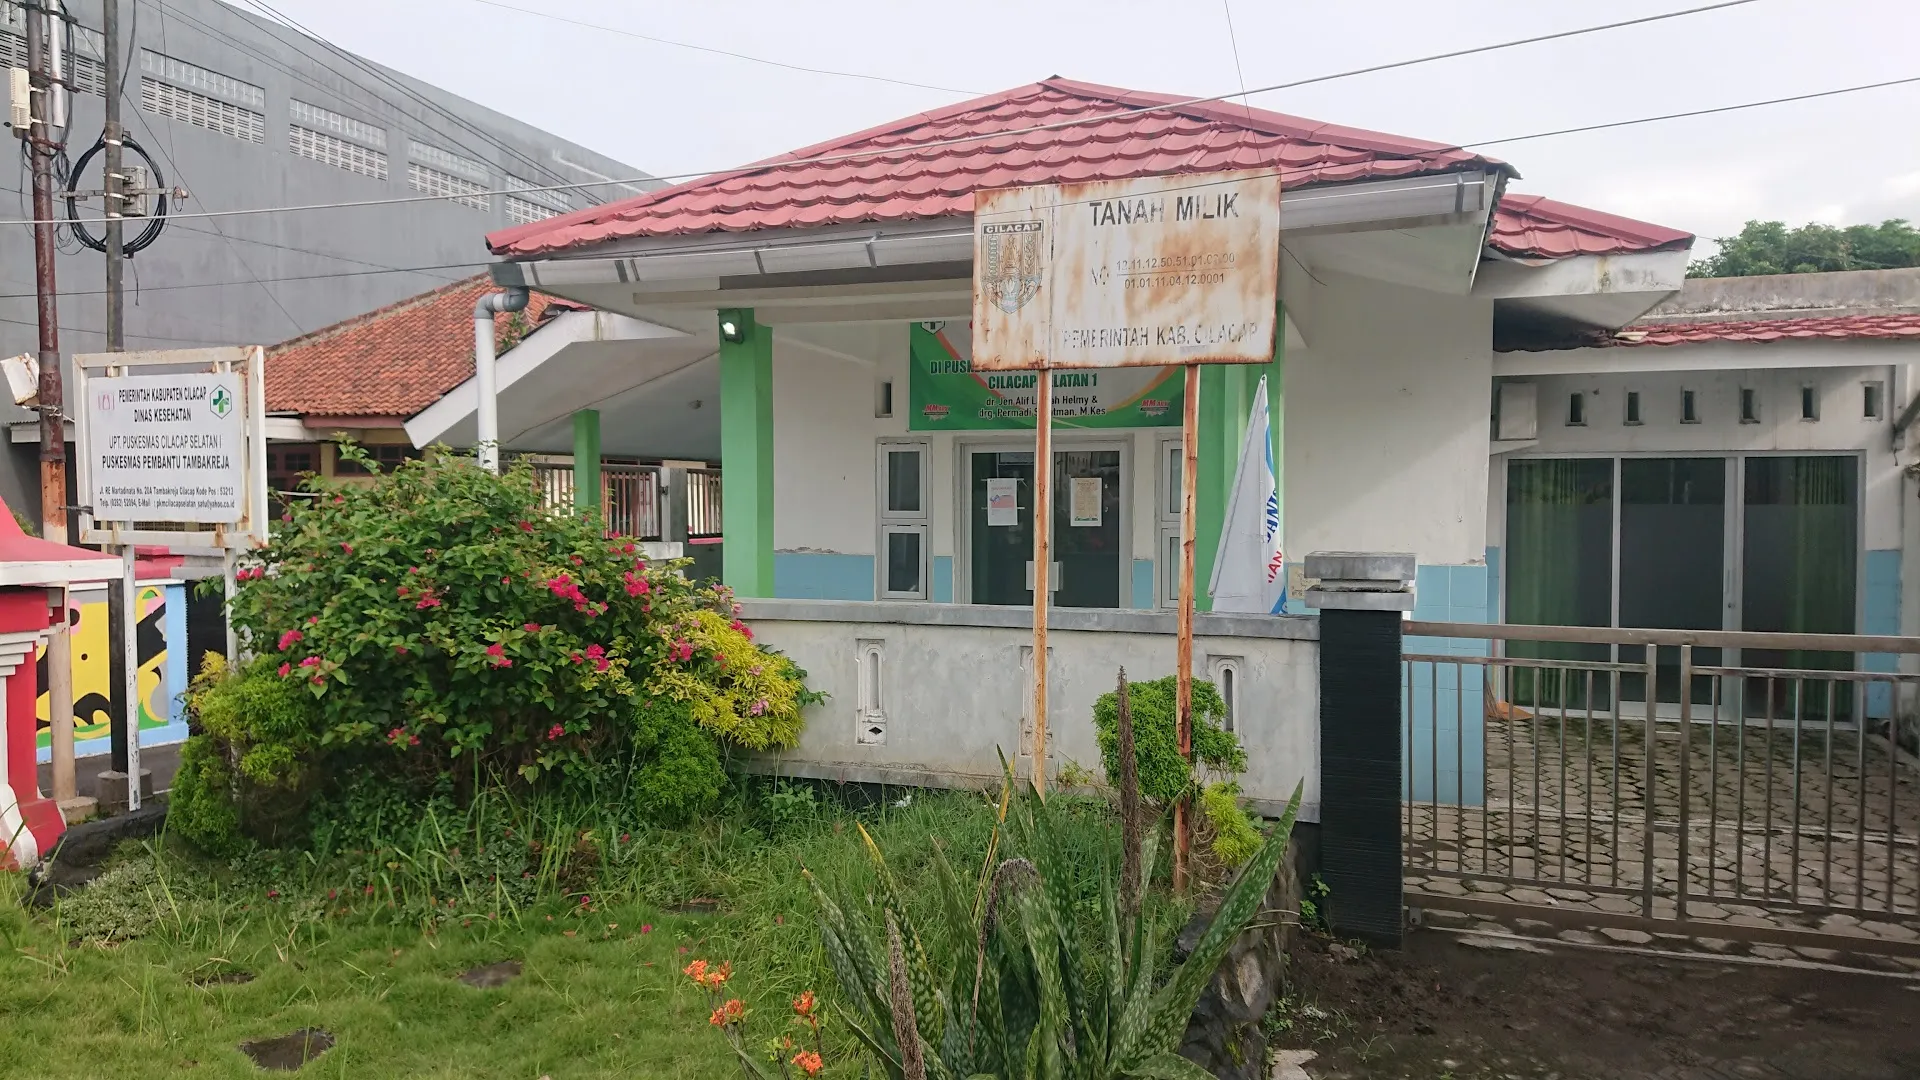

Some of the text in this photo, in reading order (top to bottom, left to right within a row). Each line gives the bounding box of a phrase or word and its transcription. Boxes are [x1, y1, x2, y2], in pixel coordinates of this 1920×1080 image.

[1089, 192, 1239, 226] TANAH MILIK
[986, 223, 1041, 233] CILACAP
[1124, 272, 1225, 290] 01.01.11.04.12.0001
[1156, 325, 1190, 346] KAB.
[1195, 322, 1258, 344] CLACAP
[988, 372, 1098, 389] CILACAP LATAN 1
[119, 386, 207, 402] PEMERINTAH KABUPATEN CILACAP
[999, 397, 1013, 406] Jen
[1016, 395, 1030, 405] Alif
[1062, 395, 1089, 406] Helmy
[1091, 395, 1098, 404] &
[134, 407, 192, 422] DINAS KESEHATAN
[997, 407, 1032, 417] Permadi
[1080, 406, 1106, 416] M.Kes
[123, 435, 160, 449] PUSKESMAS
[161, 434, 189, 449] CILACAP
[189, 434, 218, 449] SELATAN
[102, 455, 230, 469] PUSKESMAS PEMBANTU TAMBAKREJA
[153, 486, 179, 496] Tambakreja
[196, 486, 207, 496] Kode
